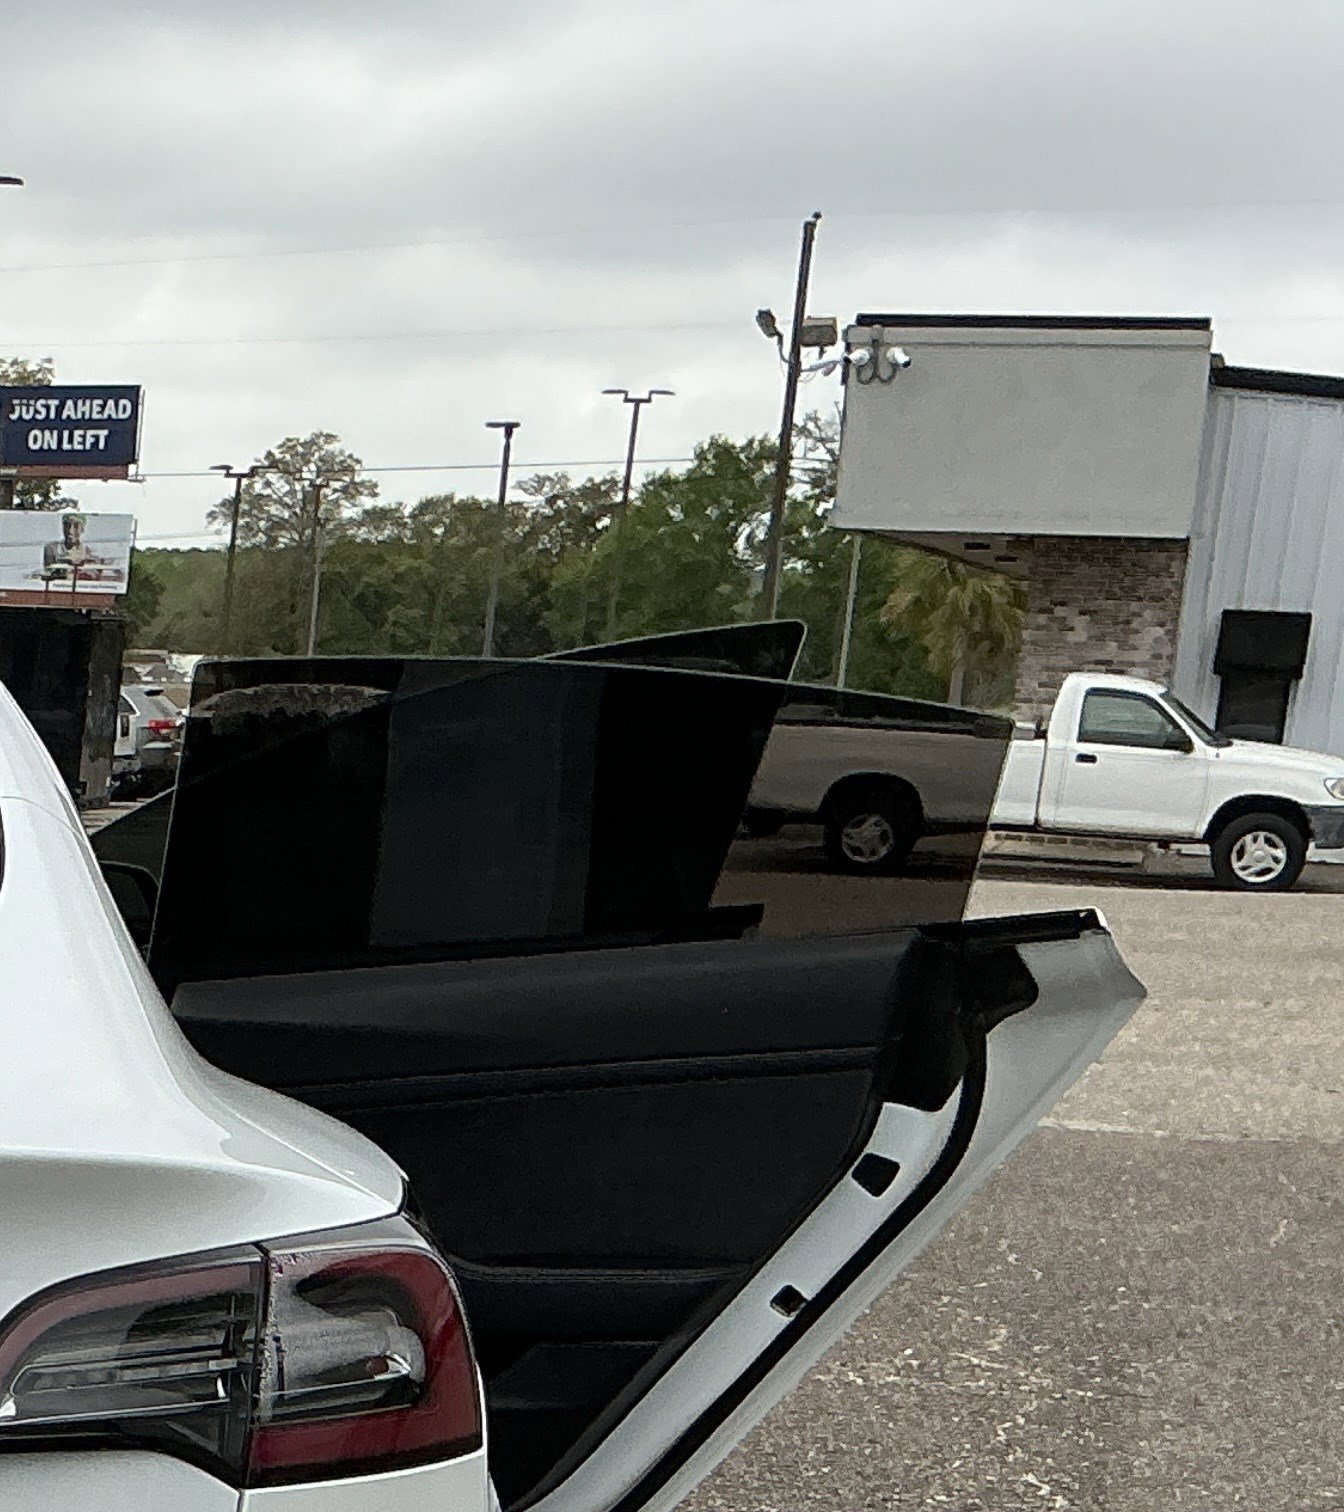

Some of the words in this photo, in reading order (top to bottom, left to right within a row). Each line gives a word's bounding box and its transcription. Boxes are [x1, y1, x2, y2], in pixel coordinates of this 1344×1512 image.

[9, 399, 59, 420] JUST
[61, 398, 132, 420] AHEAD
[27, 429, 58, 450] ON
[62, 429, 109, 451] LEFT
